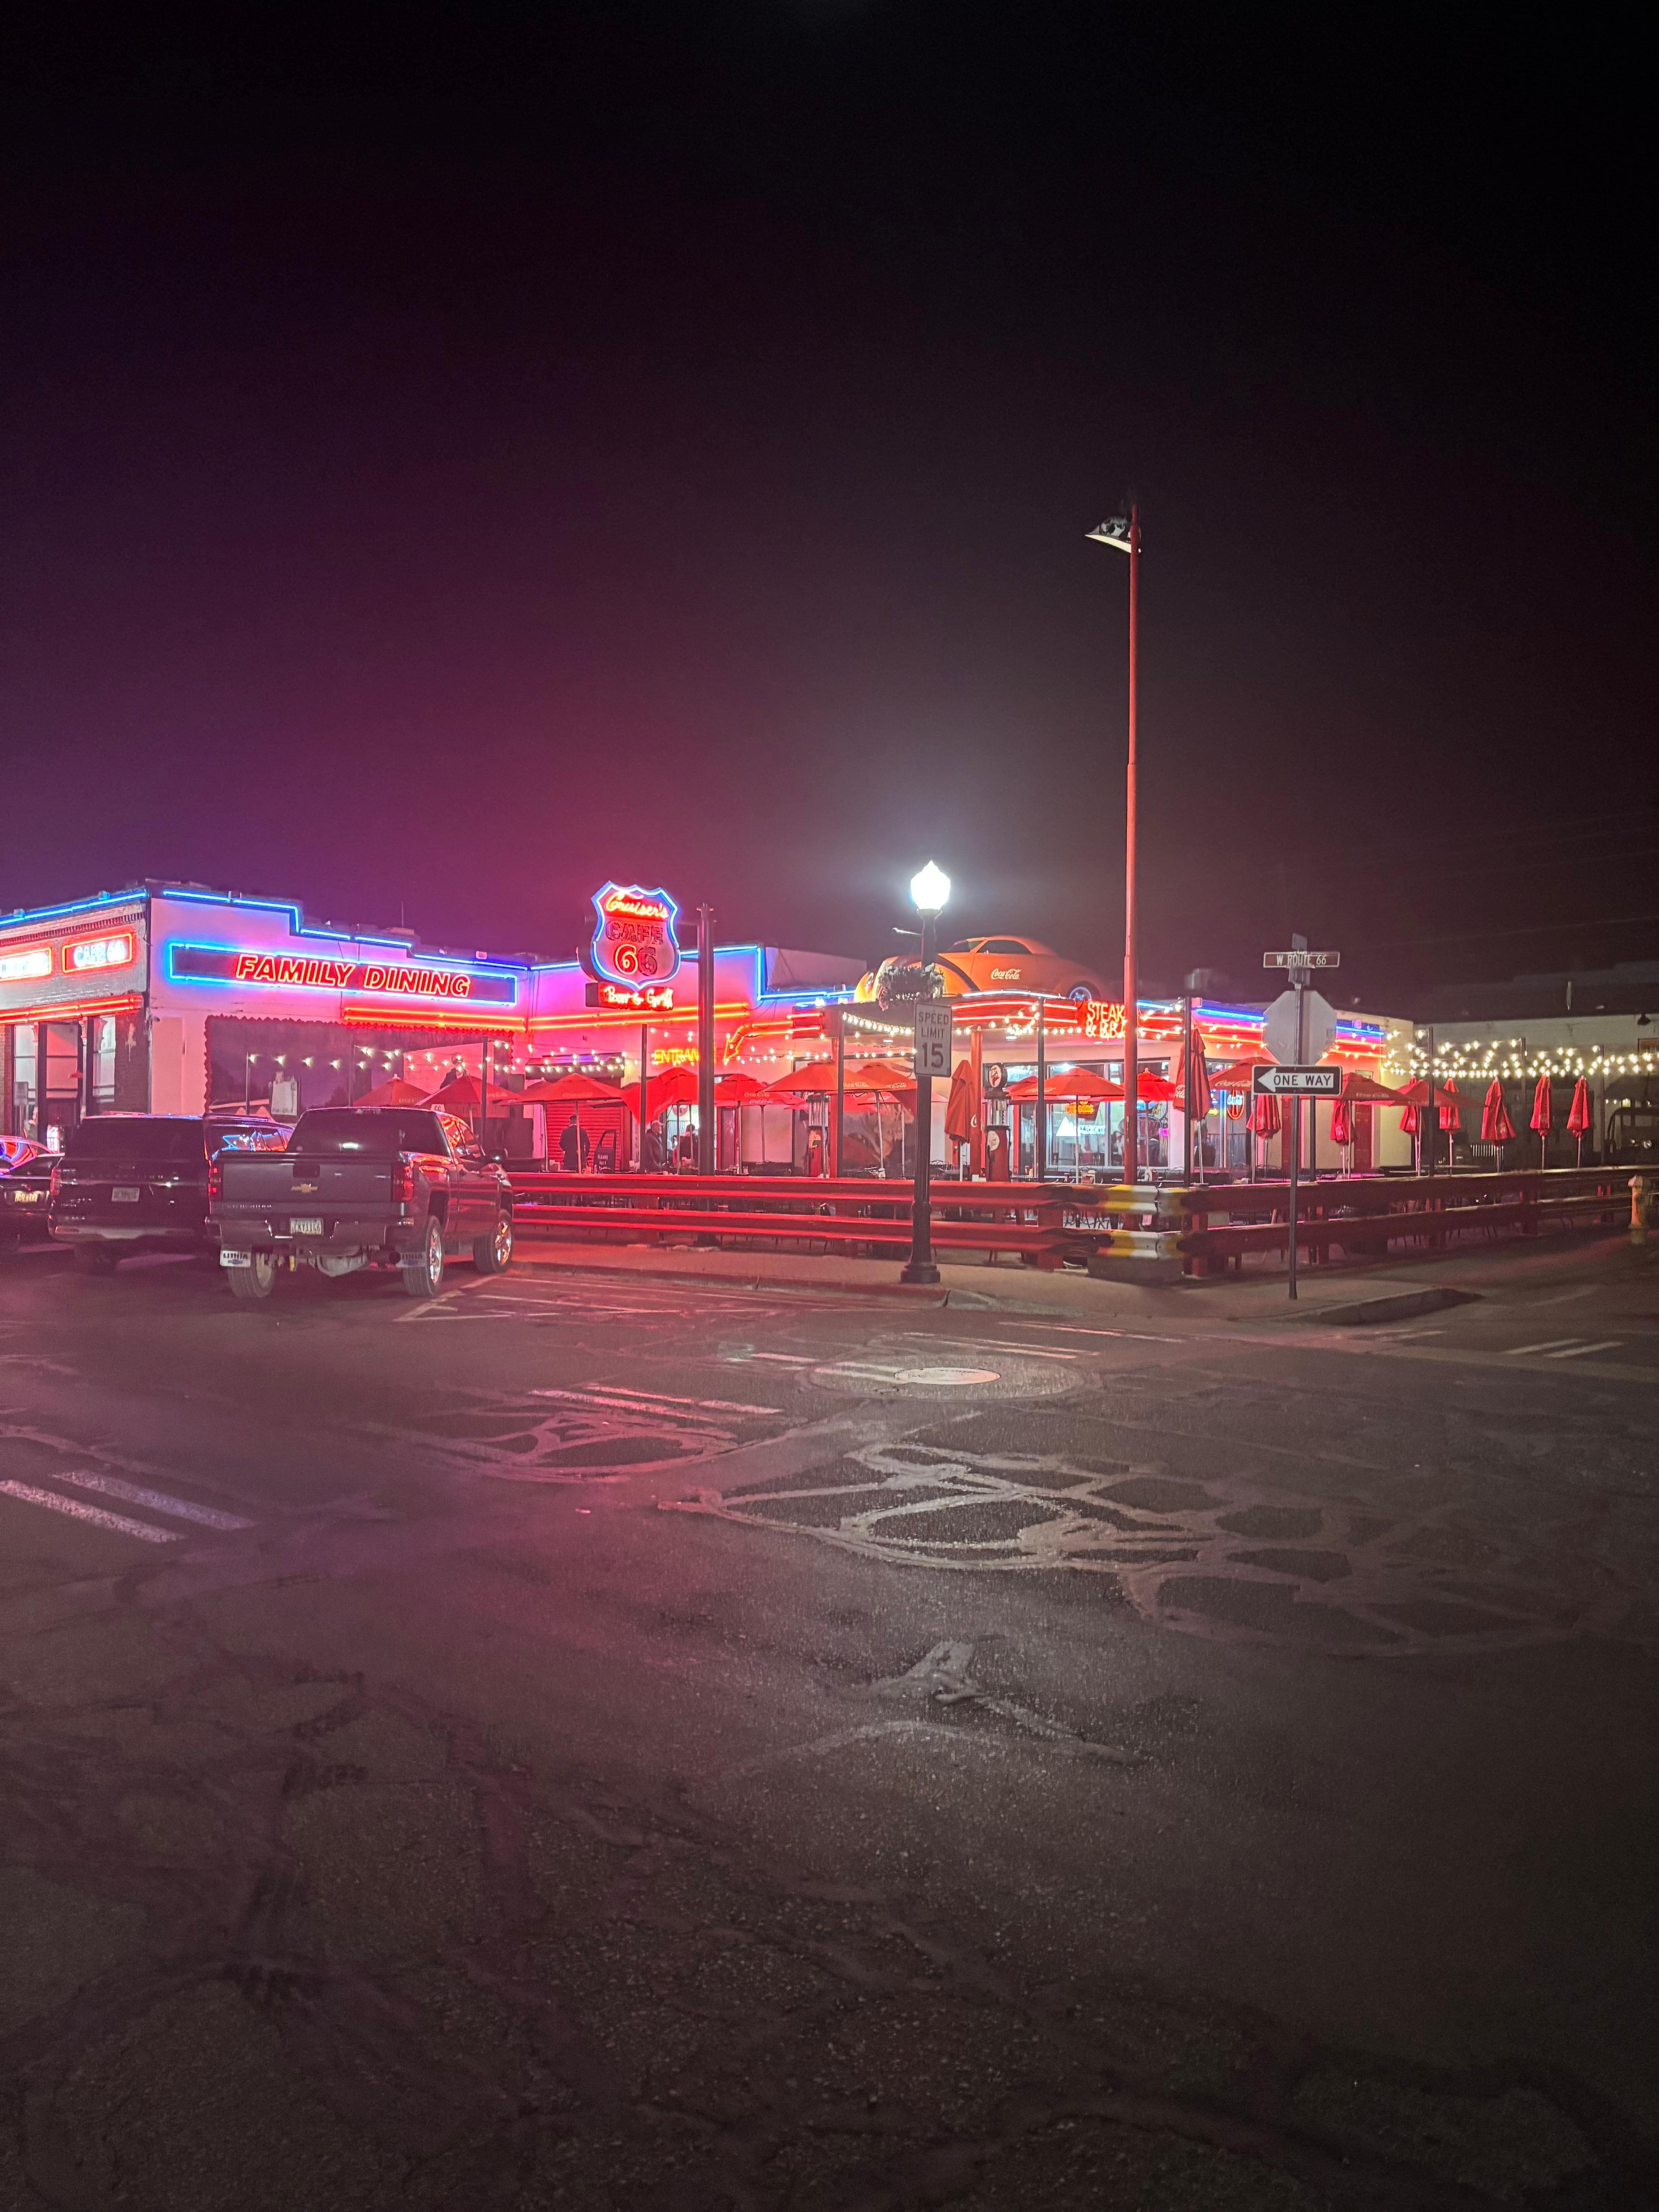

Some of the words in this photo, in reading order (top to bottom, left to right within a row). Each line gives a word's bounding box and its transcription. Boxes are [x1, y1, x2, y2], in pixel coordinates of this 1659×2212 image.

[606, 891, 669, 919] Cruiser's
[605, 920, 663, 945] CAFE
[613, 944, 658, 976] 66
[1276, 954, 1283, 965] W
[1287, 954, 1312, 967] ROUTE
[1316, 954, 1326, 965] 66
[235, 954, 356, 987] FAMILY
[364, 965, 471, 997] DINING
[918, 1011, 949, 1025] SPEED
[1085, 1018, 1097, 1037] &
[921, 1026, 945, 1038] LIMIT
[654, 1048, 700, 1063] ENTRAN
[922, 1042, 944, 1068] 15
[1274, 1075, 1298, 1086] ONE
[1305, 1075, 1331, 1086] WAY
